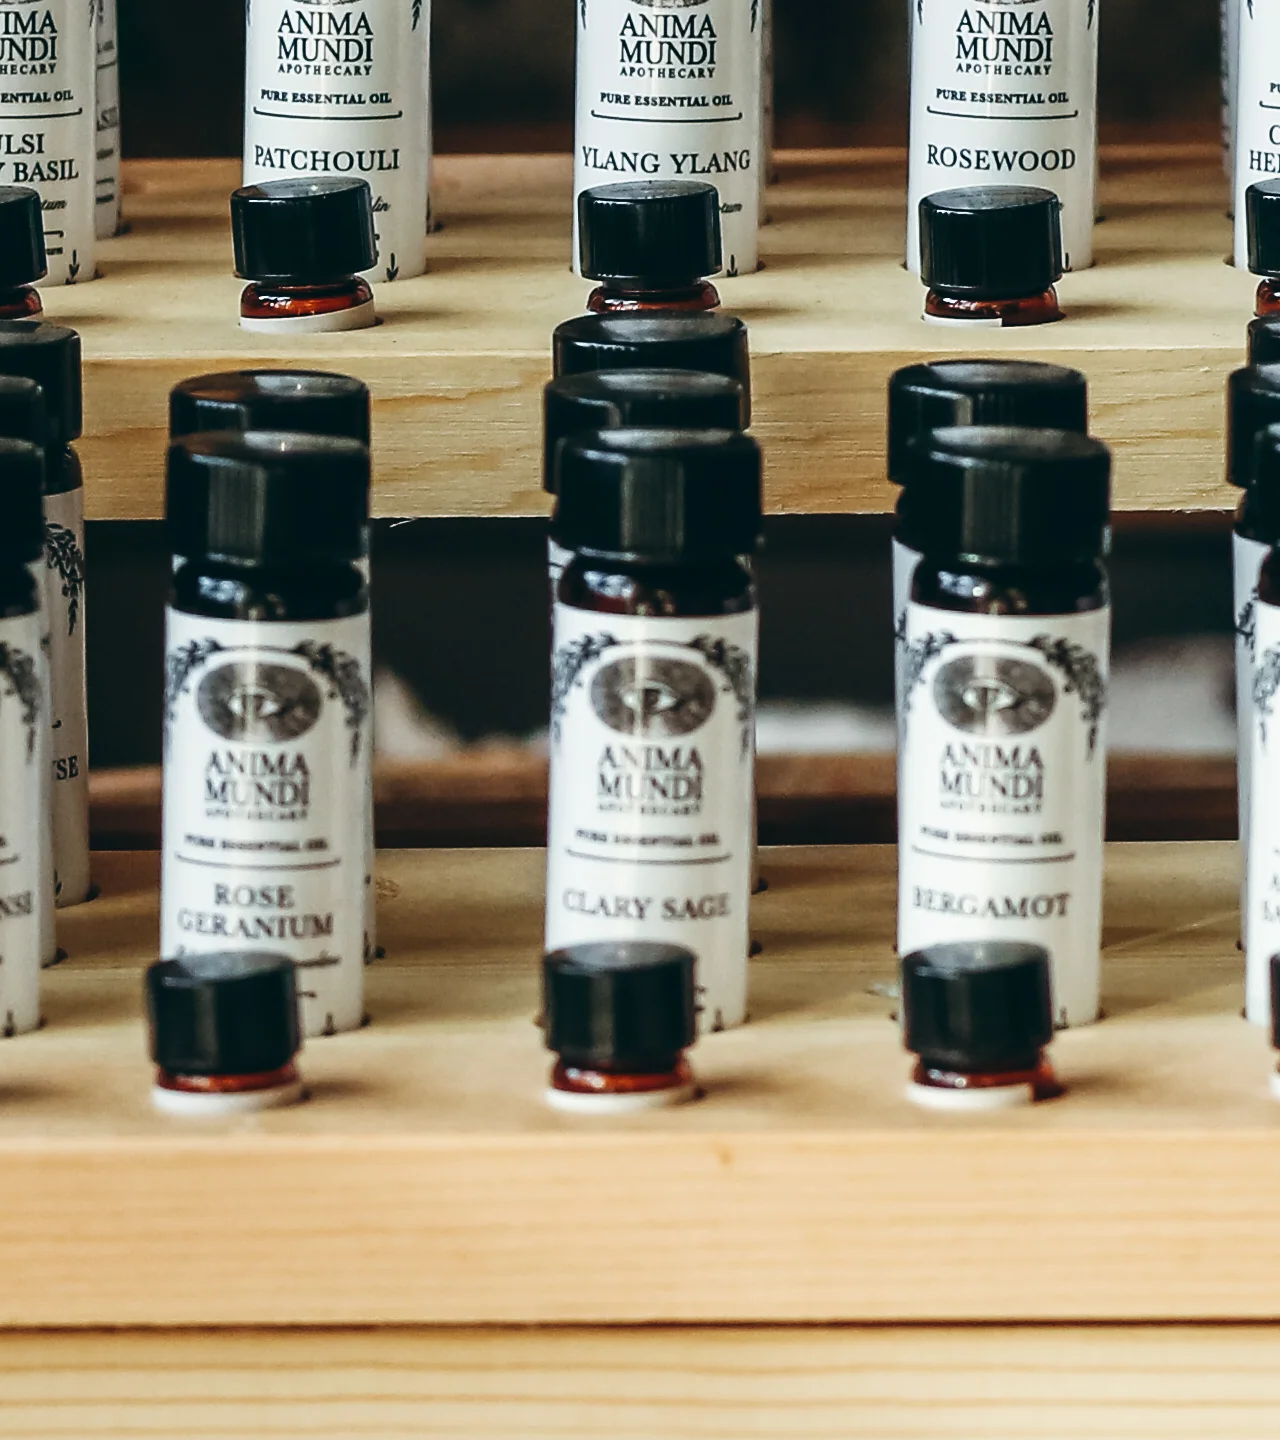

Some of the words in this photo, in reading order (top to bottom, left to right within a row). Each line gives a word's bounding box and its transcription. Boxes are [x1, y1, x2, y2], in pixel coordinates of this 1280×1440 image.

[277, 11, 373, 35] ANIMA
[619, 13, 716, 38] ANIMA
[956, 10, 1053, 35] ANIMA
[277, 36, 373, 62] MUNDI
[620, 39, 716, 65] MUNDI
[956, 35, 1052, 62] MUNDI
[278, 64, 372, 75] APOTHECARY
[620, 67, 715, 78] APOTHECARY
[956, 64, 1052, 75] APOTHECARY
[54, 90, 73, 101] OIL
[261, 89, 288, 102] PURE
[292, 93, 366, 104] ESSENTIAL
[370, 93, 391, 103] OIL
[600, 93, 631, 105] PURE
[635, 96, 709, 107] ESSENTIAL
[713, 94, 732, 105] OIL
[936, 89, 966, 101] PURE
[971, 93, 1045, 104] ESSENTIAL
[1049, 92, 1068, 103] OIL
[13, 159, 79, 182] BASIL
[255, 145, 399, 171] PATCHOULI
[582, 146, 660, 173] YLANG
[670, 150, 750, 174] YLANG
[927, 144, 1075, 171] ROSEWOOD
[206, 750, 309, 776] ANIMA
[598, 745, 703, 770] ANIMA
[940, 743, 1044, 769] ANIMA
[205, 778, 309, 806] MUNDI
[597, 773, 702, 800] MUNDI
[940, 770, 1044, 799] MUNDI
[214, 883, 294, 907] ROSE
[562, 889, 652, 919] CLARY
[661, 891, 732, 919] SAGE
[912, 885, 1071, 918] BERGAMOT
[178, 907, 333, 938] GERANIUM
